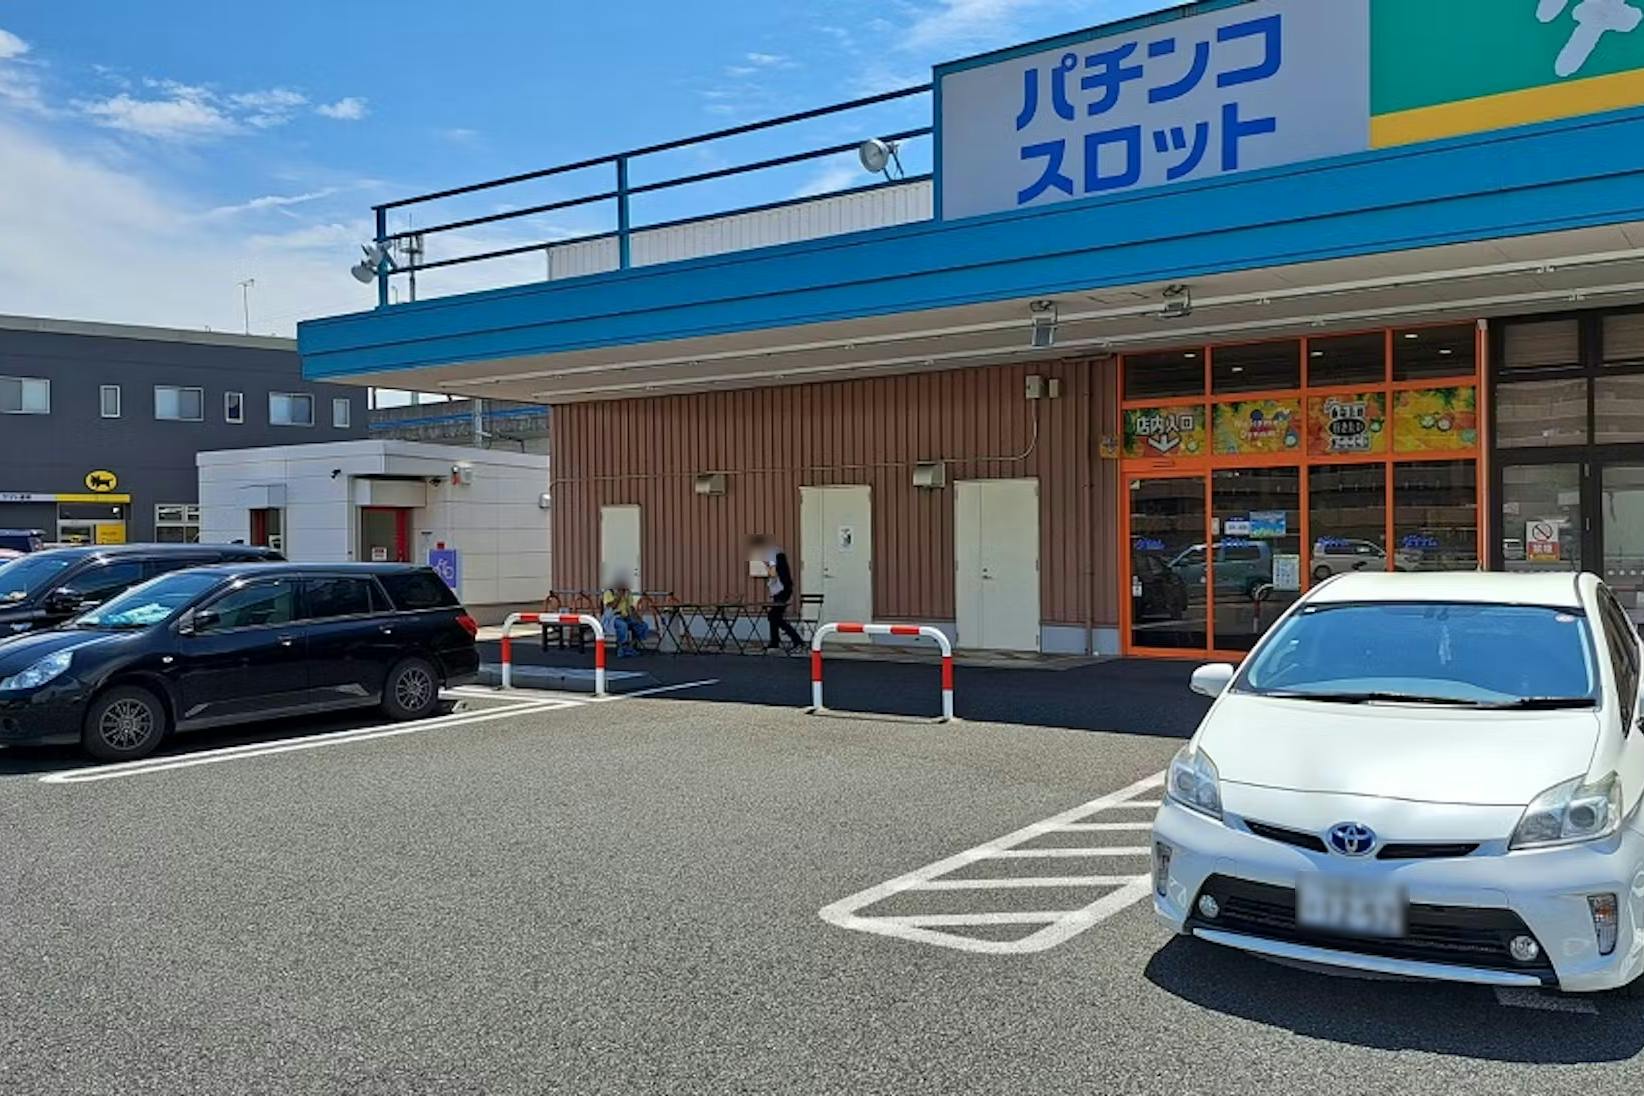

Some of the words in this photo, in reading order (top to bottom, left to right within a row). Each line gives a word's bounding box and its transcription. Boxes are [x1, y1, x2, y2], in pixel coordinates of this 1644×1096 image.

[1017, 15, 1282, 130] パチンコ
[1017, 102, 1277, 205] スロット
[1136, 413, 1194, 435] 店内入口
